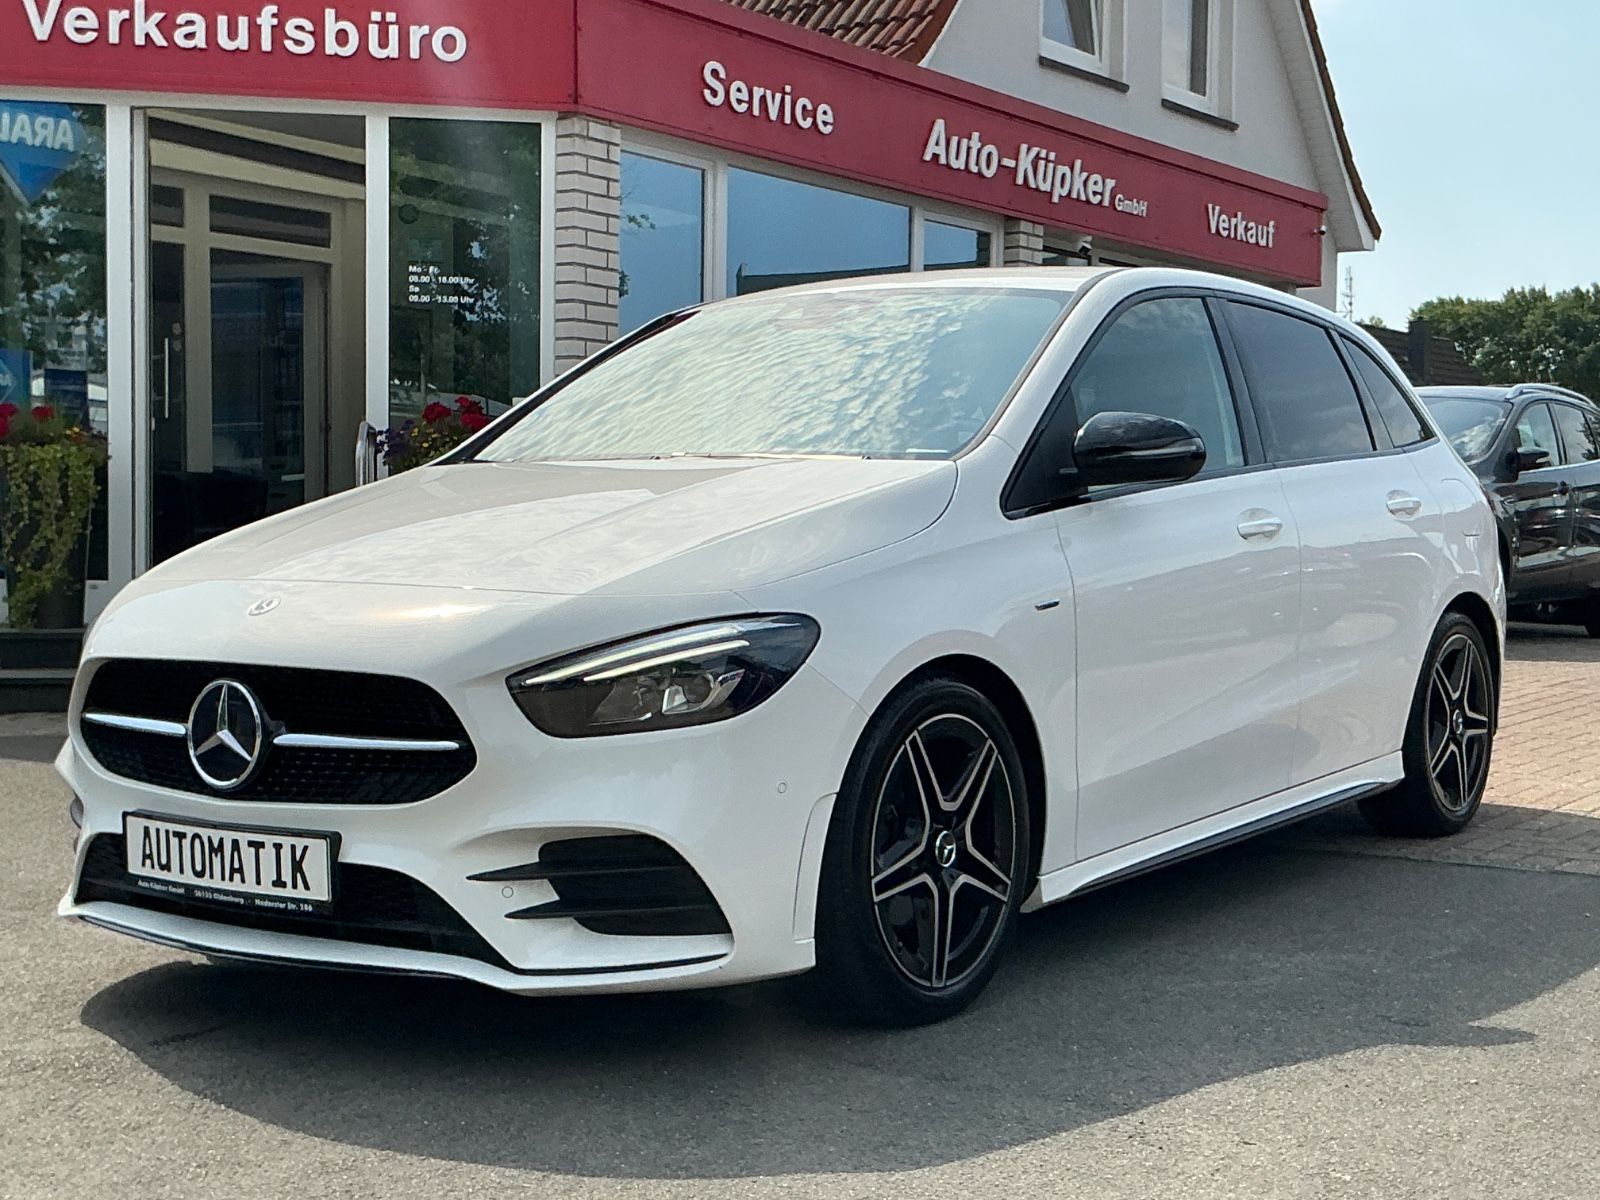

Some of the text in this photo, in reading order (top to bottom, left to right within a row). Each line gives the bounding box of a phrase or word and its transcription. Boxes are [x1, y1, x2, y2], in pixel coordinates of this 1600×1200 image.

[22, 0, 467, 63] Verkaufsbüro
[703, 60, 834, 135] Service
[922, 118, 1148, 217] Auto-Küpker GmbH
[1207, 203, 1275, 248] Verkauf
[408, 265, 422, 273] Mo
[460, 276, 475, 284] Uhr
[460, 295, 475, 304] Uhr
[141, 826, 311, 892] AUTOMATIK
